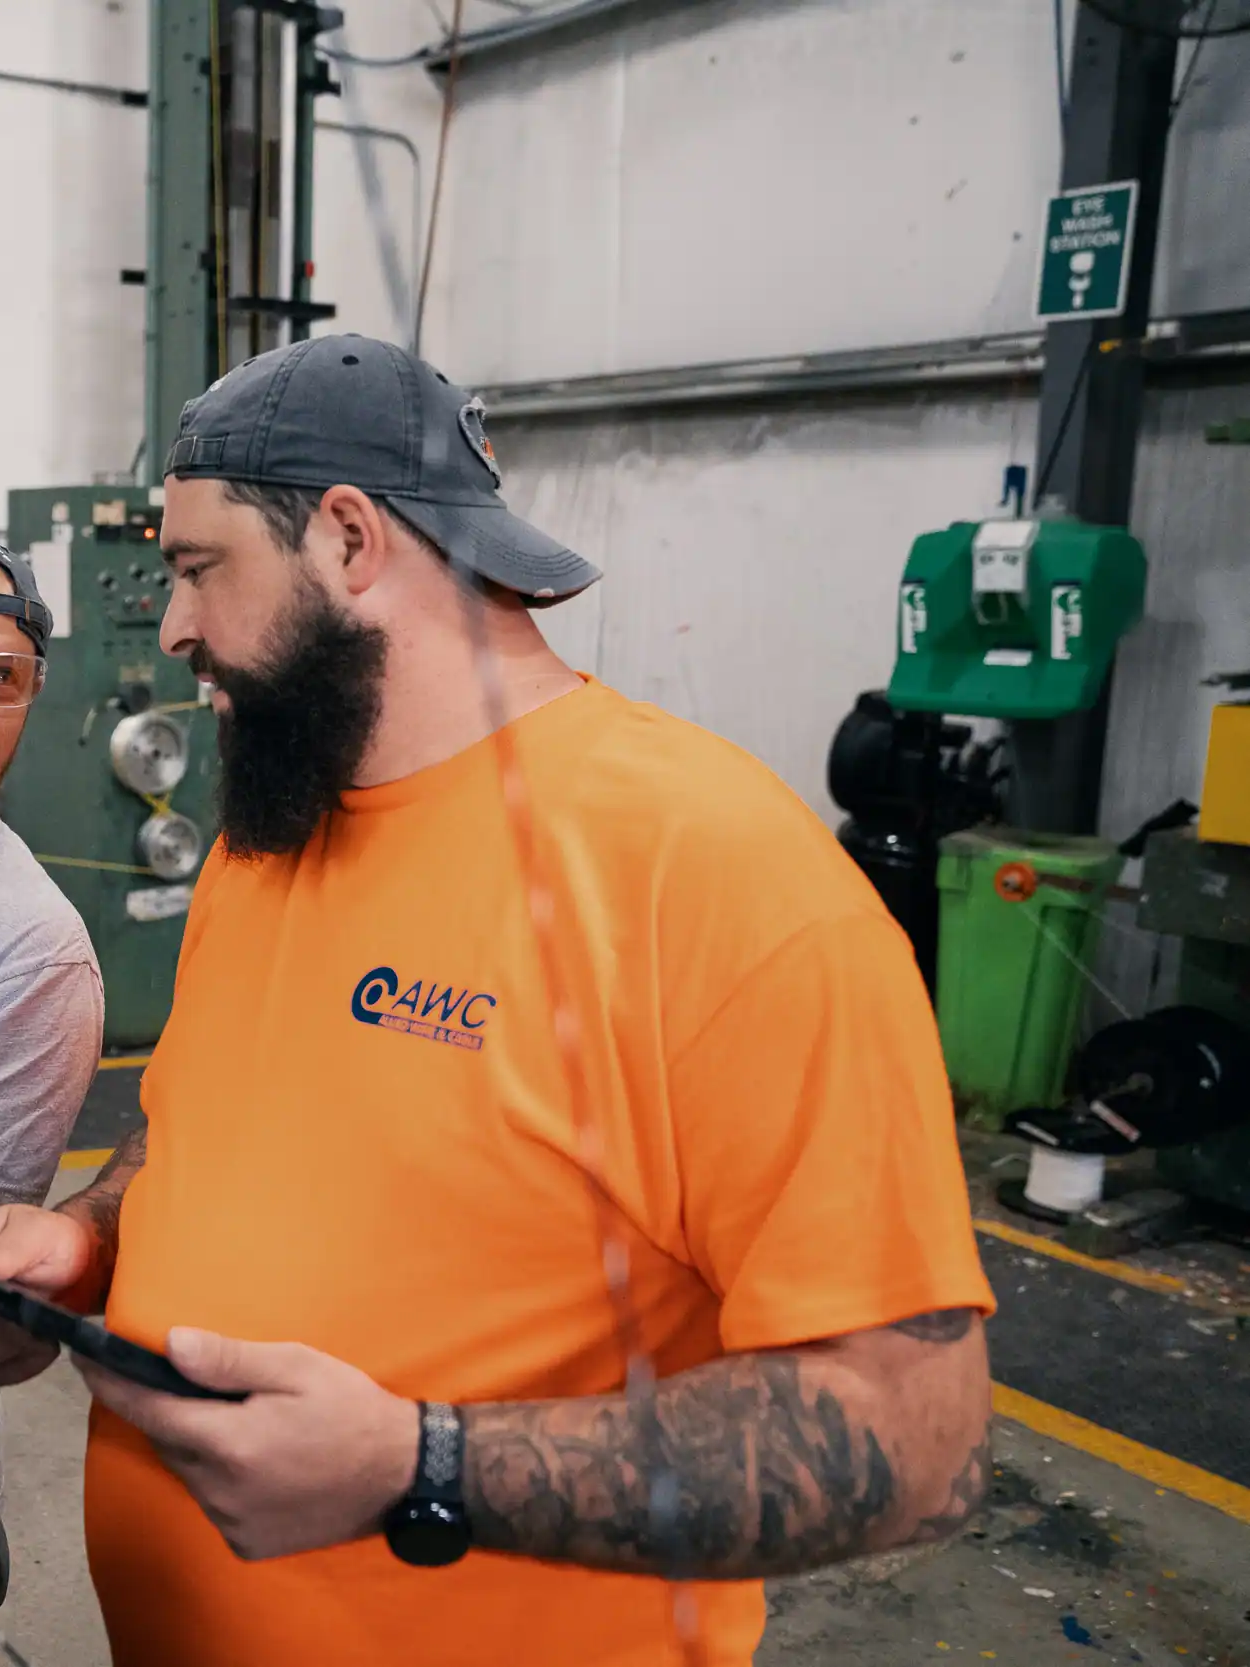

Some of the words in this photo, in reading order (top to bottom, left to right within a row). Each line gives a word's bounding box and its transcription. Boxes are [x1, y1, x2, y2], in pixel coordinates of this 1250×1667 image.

[1071, 195, 1107, 216] EYE
[1061, 213, 1114, 234] WASH
[1049, 230, 1121, 253] STATION
[391, 980, 497, 1029] AWC
